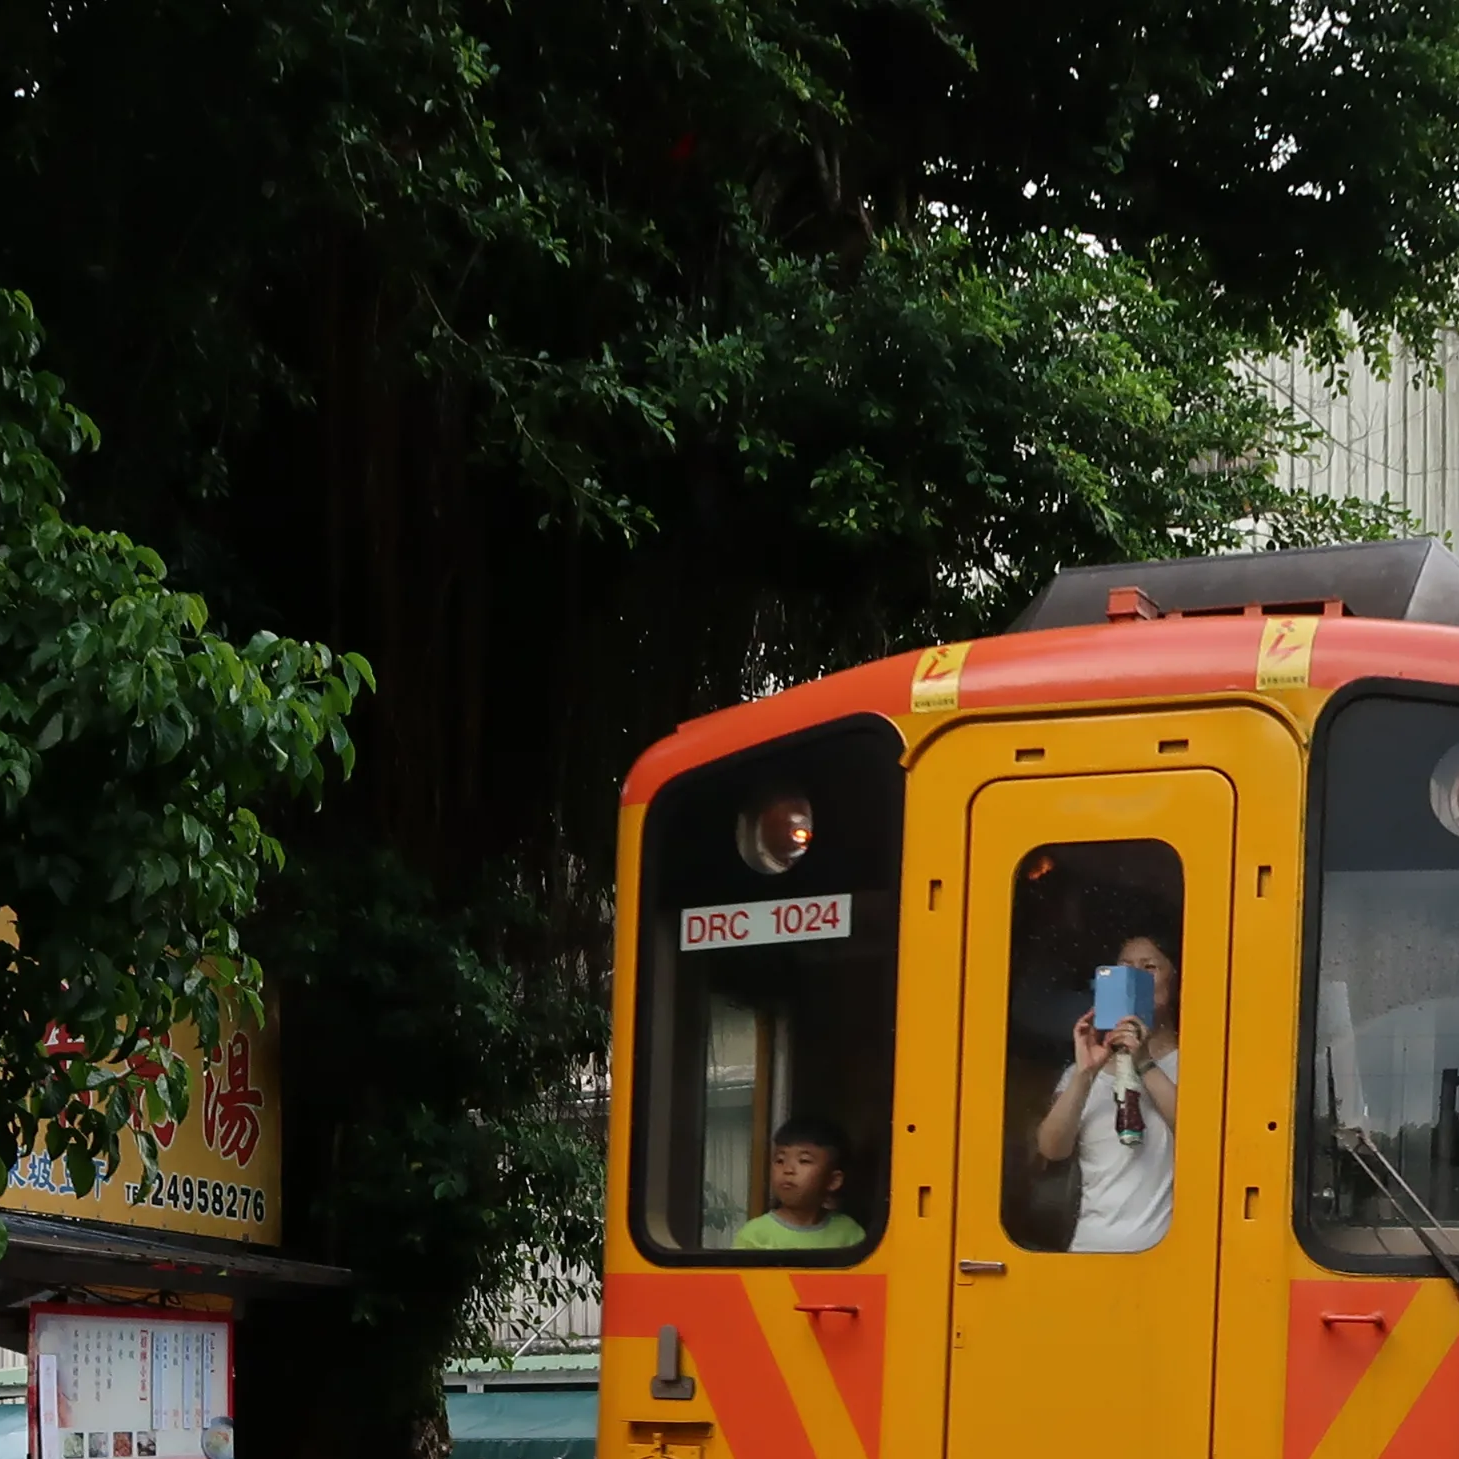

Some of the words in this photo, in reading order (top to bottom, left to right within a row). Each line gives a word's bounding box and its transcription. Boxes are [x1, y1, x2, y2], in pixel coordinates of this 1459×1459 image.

[687, 910, 749, 944] DRC
[771, 901, 840, 935] 1024
[151, 1171, 265, 1223] 24958276
